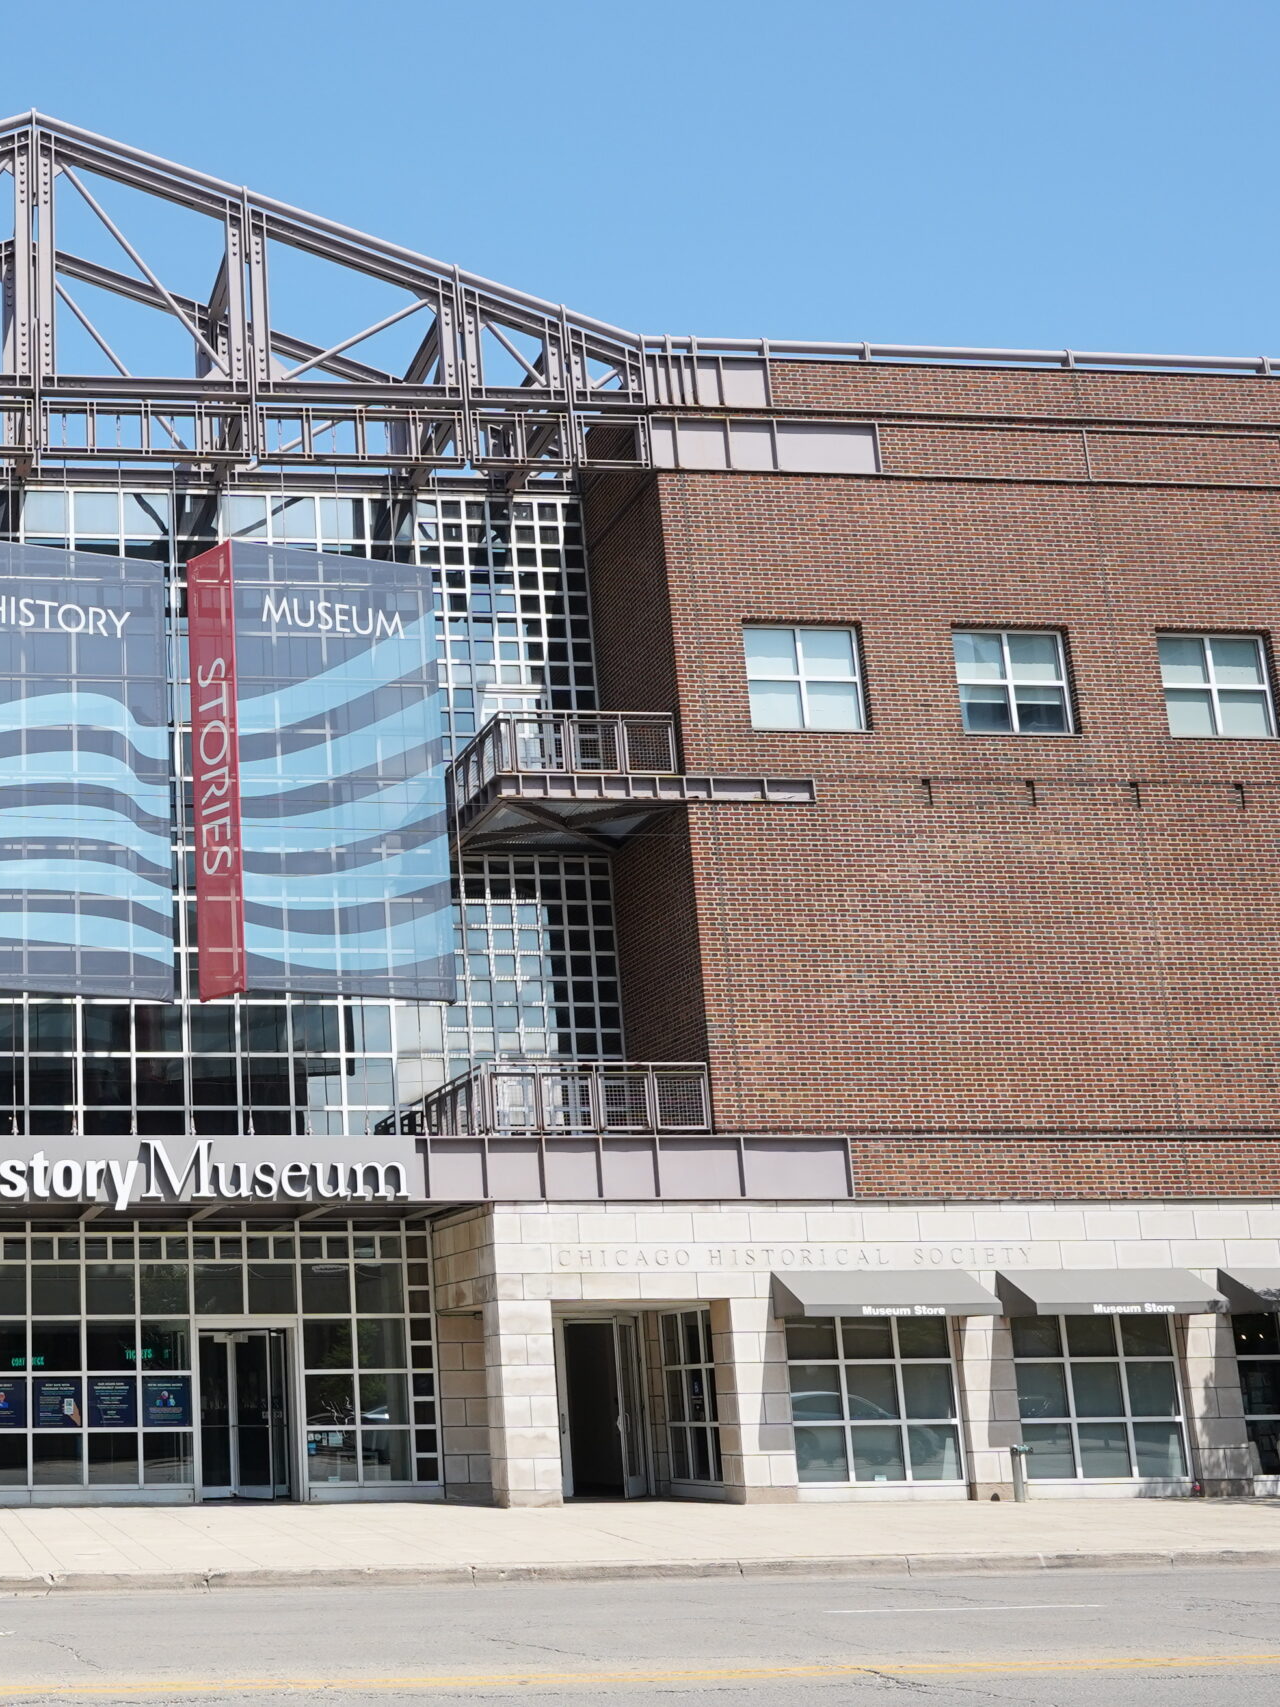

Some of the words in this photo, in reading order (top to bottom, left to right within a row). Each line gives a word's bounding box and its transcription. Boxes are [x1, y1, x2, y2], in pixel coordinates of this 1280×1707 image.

[261, 595, 405, 640] MUSEUM
[197, 657, 232, 875] STORIES
[140, 1138, 411, 1198] Museum
[557, 1248, 691, 1269] CHICAGO
[707, 1247, 890, 1268] HISTORICAL
[913, 1246, 1034, 1266] SOCIETY
[862, 1305, 911, 1316] Museum
[913, 1305, 946, 1316] Store
[1093, 1303, 1142, 1314] Museum
[1144, 1302, 1176, 1313] Store
